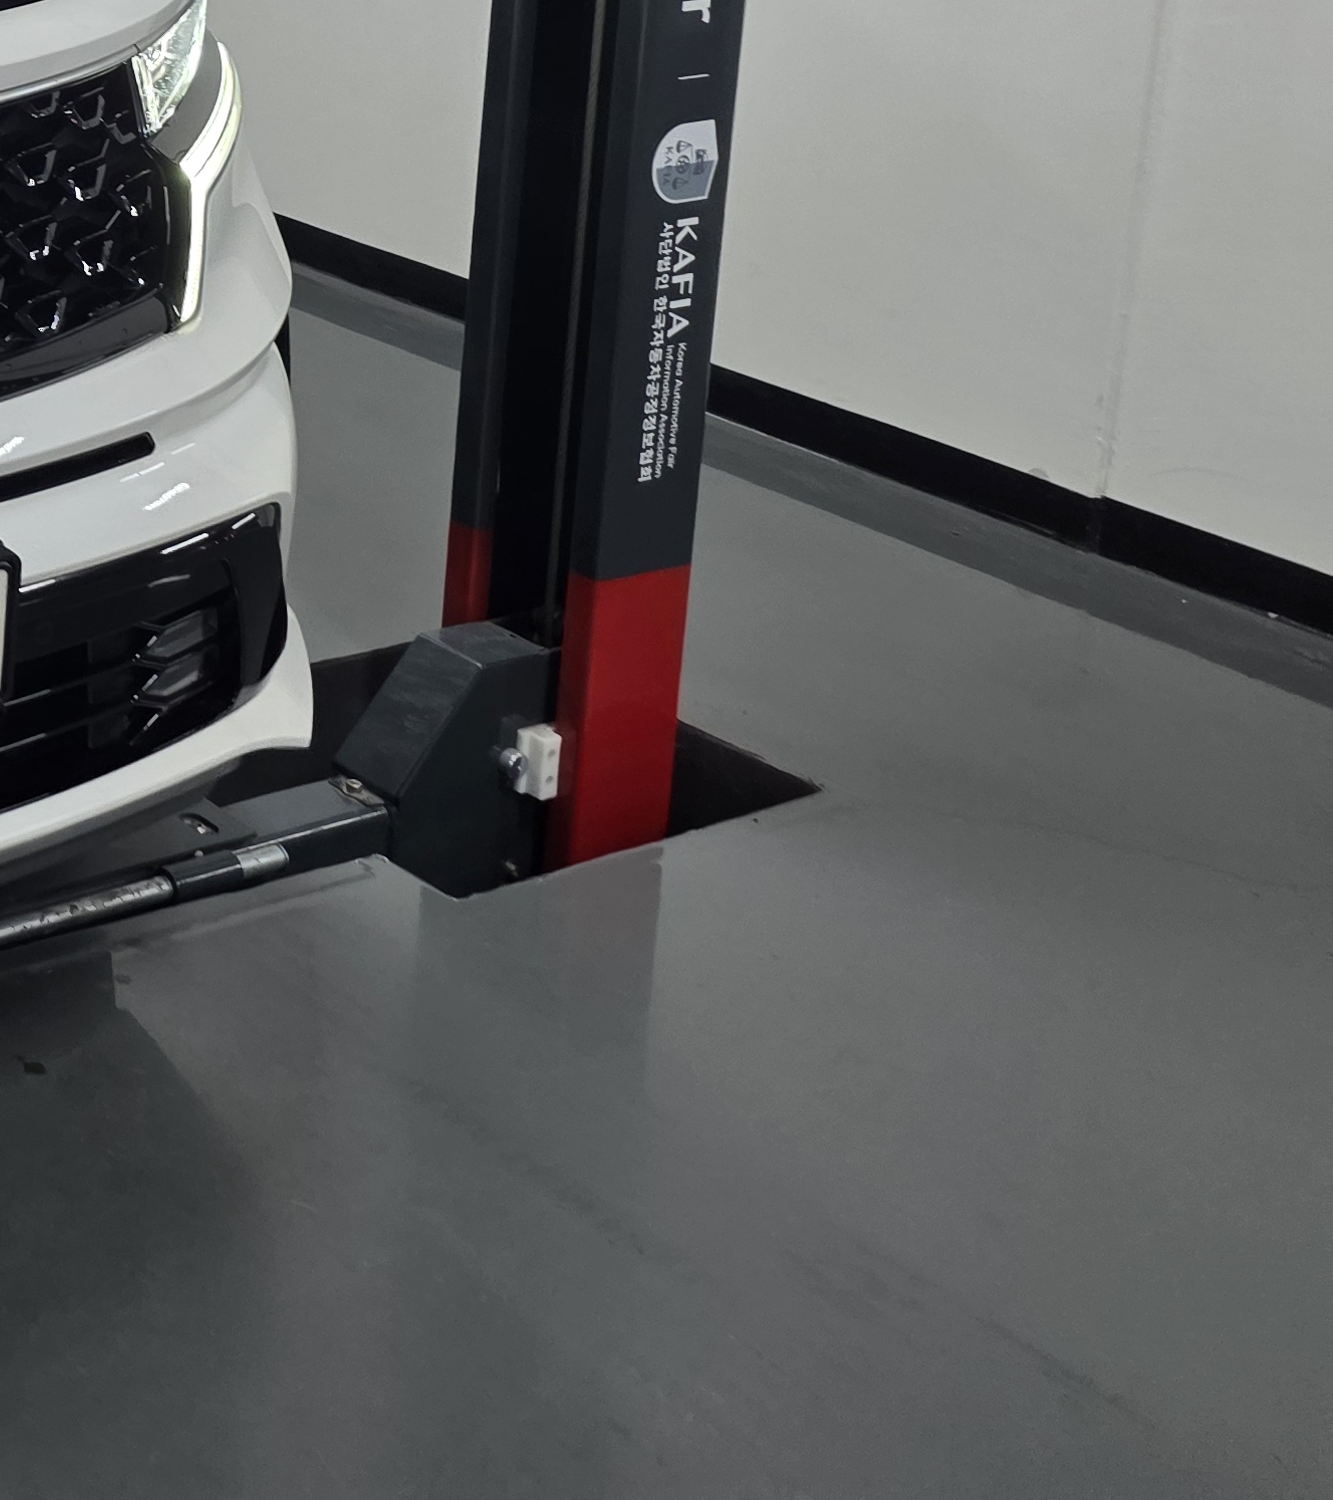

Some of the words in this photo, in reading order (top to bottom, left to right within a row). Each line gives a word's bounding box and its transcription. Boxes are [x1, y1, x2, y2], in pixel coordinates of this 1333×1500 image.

[653, 221, 675, 291] 사단법인
[666, 216, 700, 339] KAFIA
[637, 295, 669, 483] 한국자동차공정정보협회
[660, 344, 675, 412] Information
[674, 342, 688, 377] Korea
[668, 379, 684, 445] Automotive
[653, 413, 668, 479] Association
[667, 446, 678, 469] Fair
